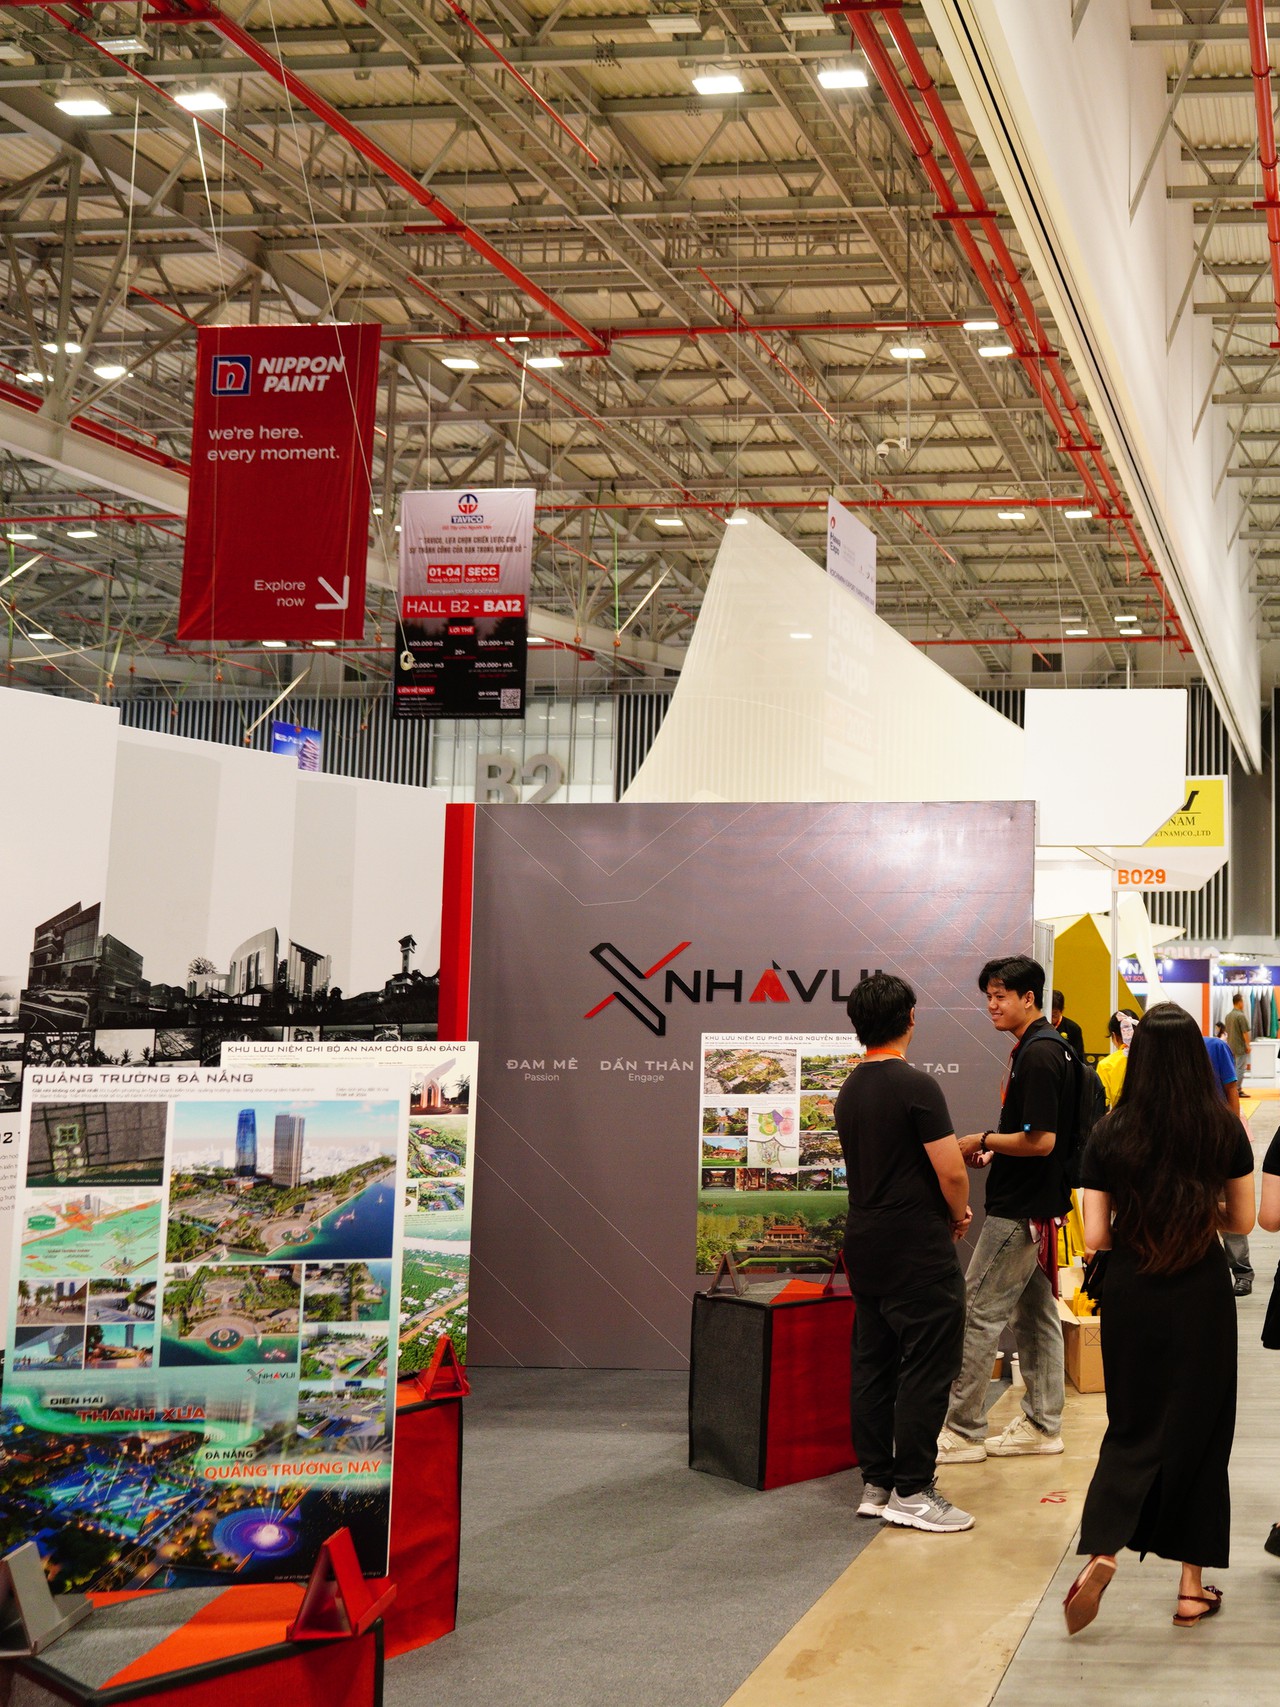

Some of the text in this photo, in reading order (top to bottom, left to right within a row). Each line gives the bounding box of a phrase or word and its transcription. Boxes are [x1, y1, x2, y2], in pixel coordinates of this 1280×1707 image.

[258, 356, 345, 374] NIPPON
[263, 375, 330, 392] PAINT
[208, 425, 303, 440] we're here.
[207, 445, 340, 463] every moment.
[429, 567, 461, 577] 01-04
[467, 567, 497, 576] SECC
[254, 579, 306, 593] Explore
[277, 596, 305, 607] now
[406, 601, 446, 613] HALL
[450, 600, 470, 613] B2
[483, 599, 521, 612] BA12
[665, 959, 883, 1003] NHÀVU
[506, 1057, 578, 1070] ĐAM MÊ
[600, 1056, 694, 1071] DẤN THÂN
[924, 1063, 959, 1075] TẠO
[32, 1071, 93, 1084] QUẢNG
[99, 1070, 171, 1083] TRƯỜNG
[177, 1071, 200, 1083] ĐÀ
[524, 1073, 560, 1081] Passion
[628, 1073, 665, 1083] Engage
[204, 1460, 382, 1481] QUẢNG TRƯỜNG NAY
